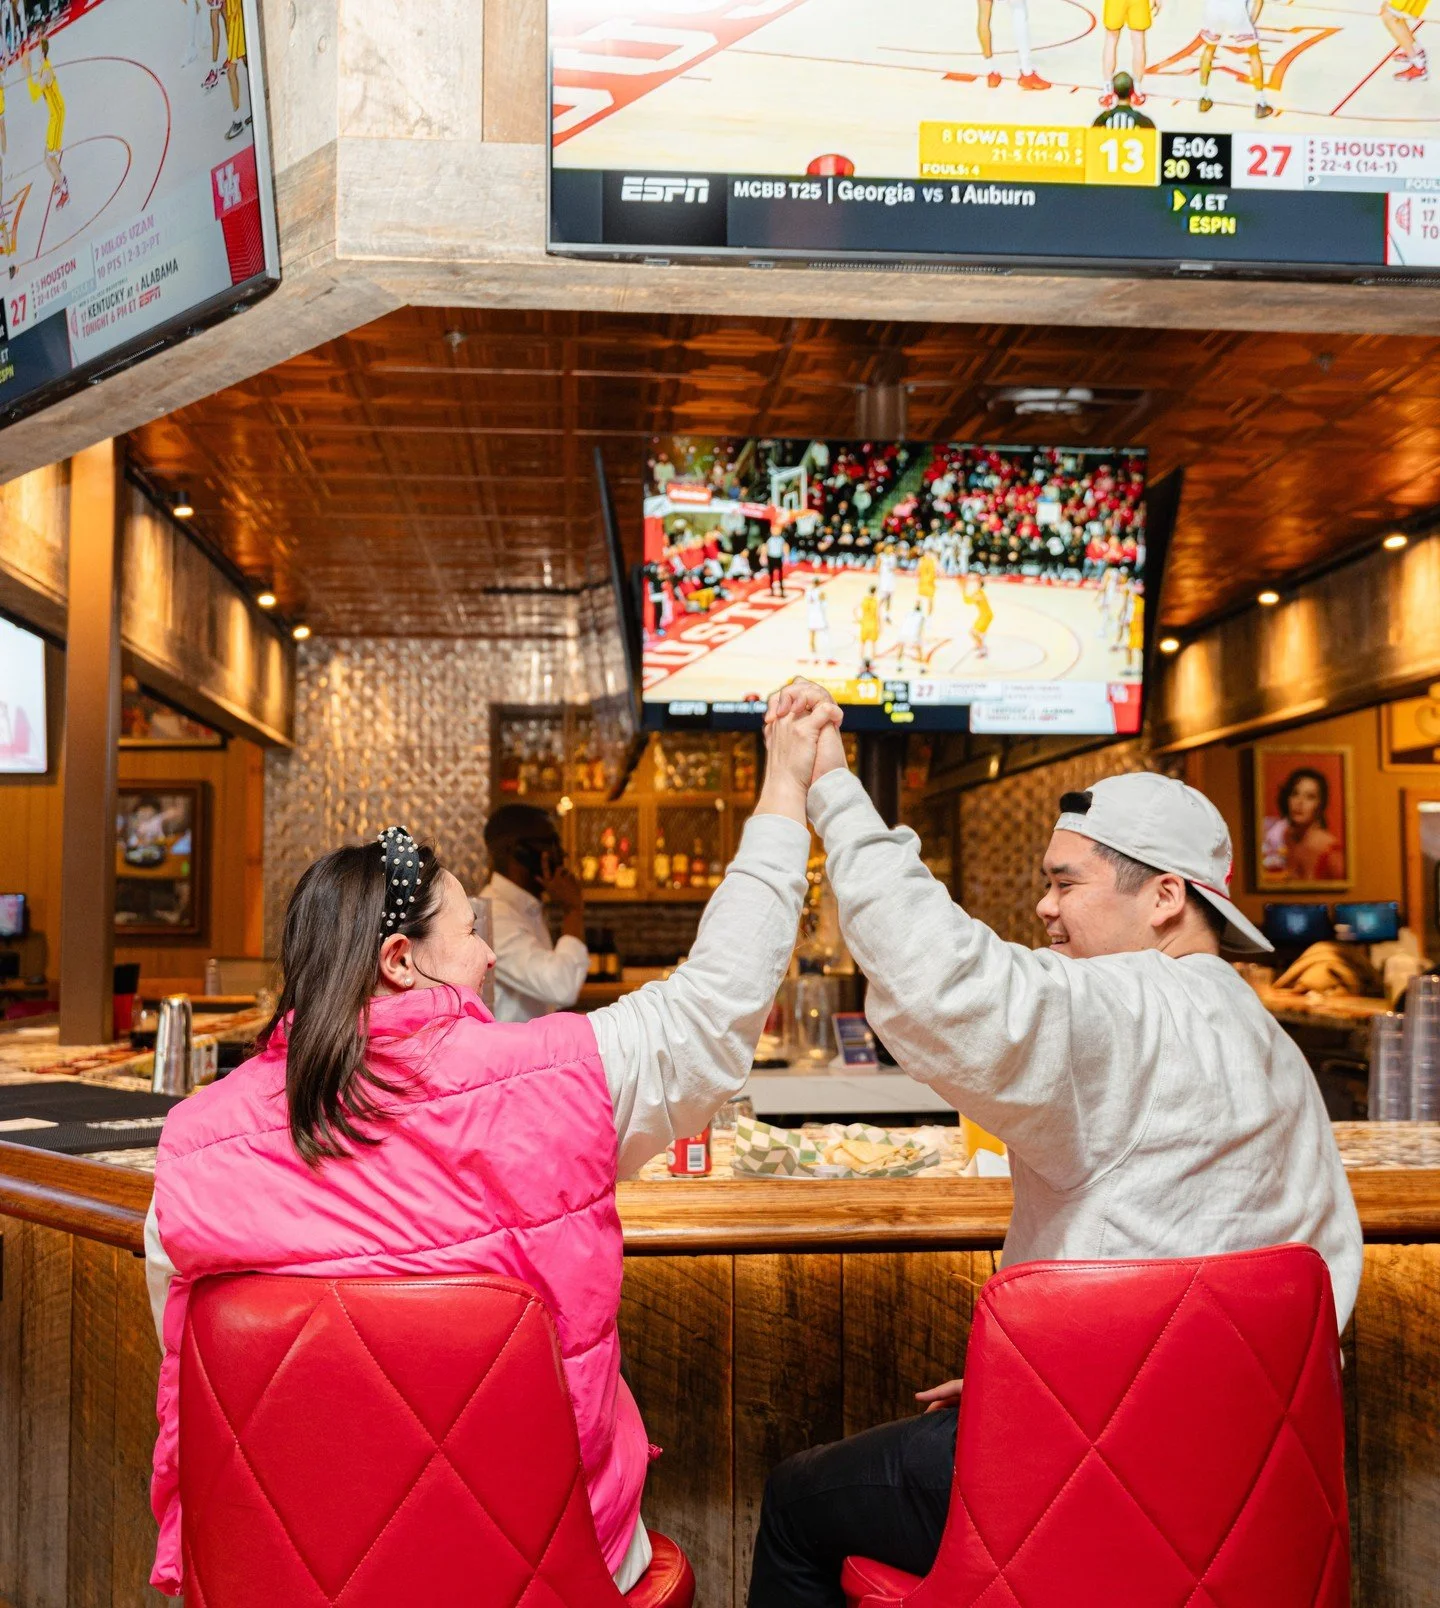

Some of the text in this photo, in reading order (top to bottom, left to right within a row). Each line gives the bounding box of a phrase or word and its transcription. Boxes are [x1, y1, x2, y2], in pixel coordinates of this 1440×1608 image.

[956, 128, 1010, 145] IOWA
[1015, 131, 1069, 147] STATE
[1171, 136, 1218, 158] 5:06
[1320, 141, 1425, 158] 5 HOUSTON
[1099, 138, 1145, 174] 13
[1163, 158, 1223, 179] 30 1st
[1247, 144, 1292, 177] 27
[1320, 160, 1397, 174] 22-4 (14-1)
[621, 176, 710, 204] ESPN
[733, 180, 786, 199] MCBB
[788, 181, 823, 200] T25
[837, 180, 916, 206] Georgia
[922, 187, 944, 202] vs
[1204, 193, 1228, 211] ET
[1189, 215, 1237, 234] ESPN
[41, 258, 76, 289] HOUSTON
[88, 287, 125, 319] KENTUCKY
[141, 258, 179, 291] ALABAMA
[10, 293, 27, 328] 27
[82, 312, 109, 338] TONIGHT
